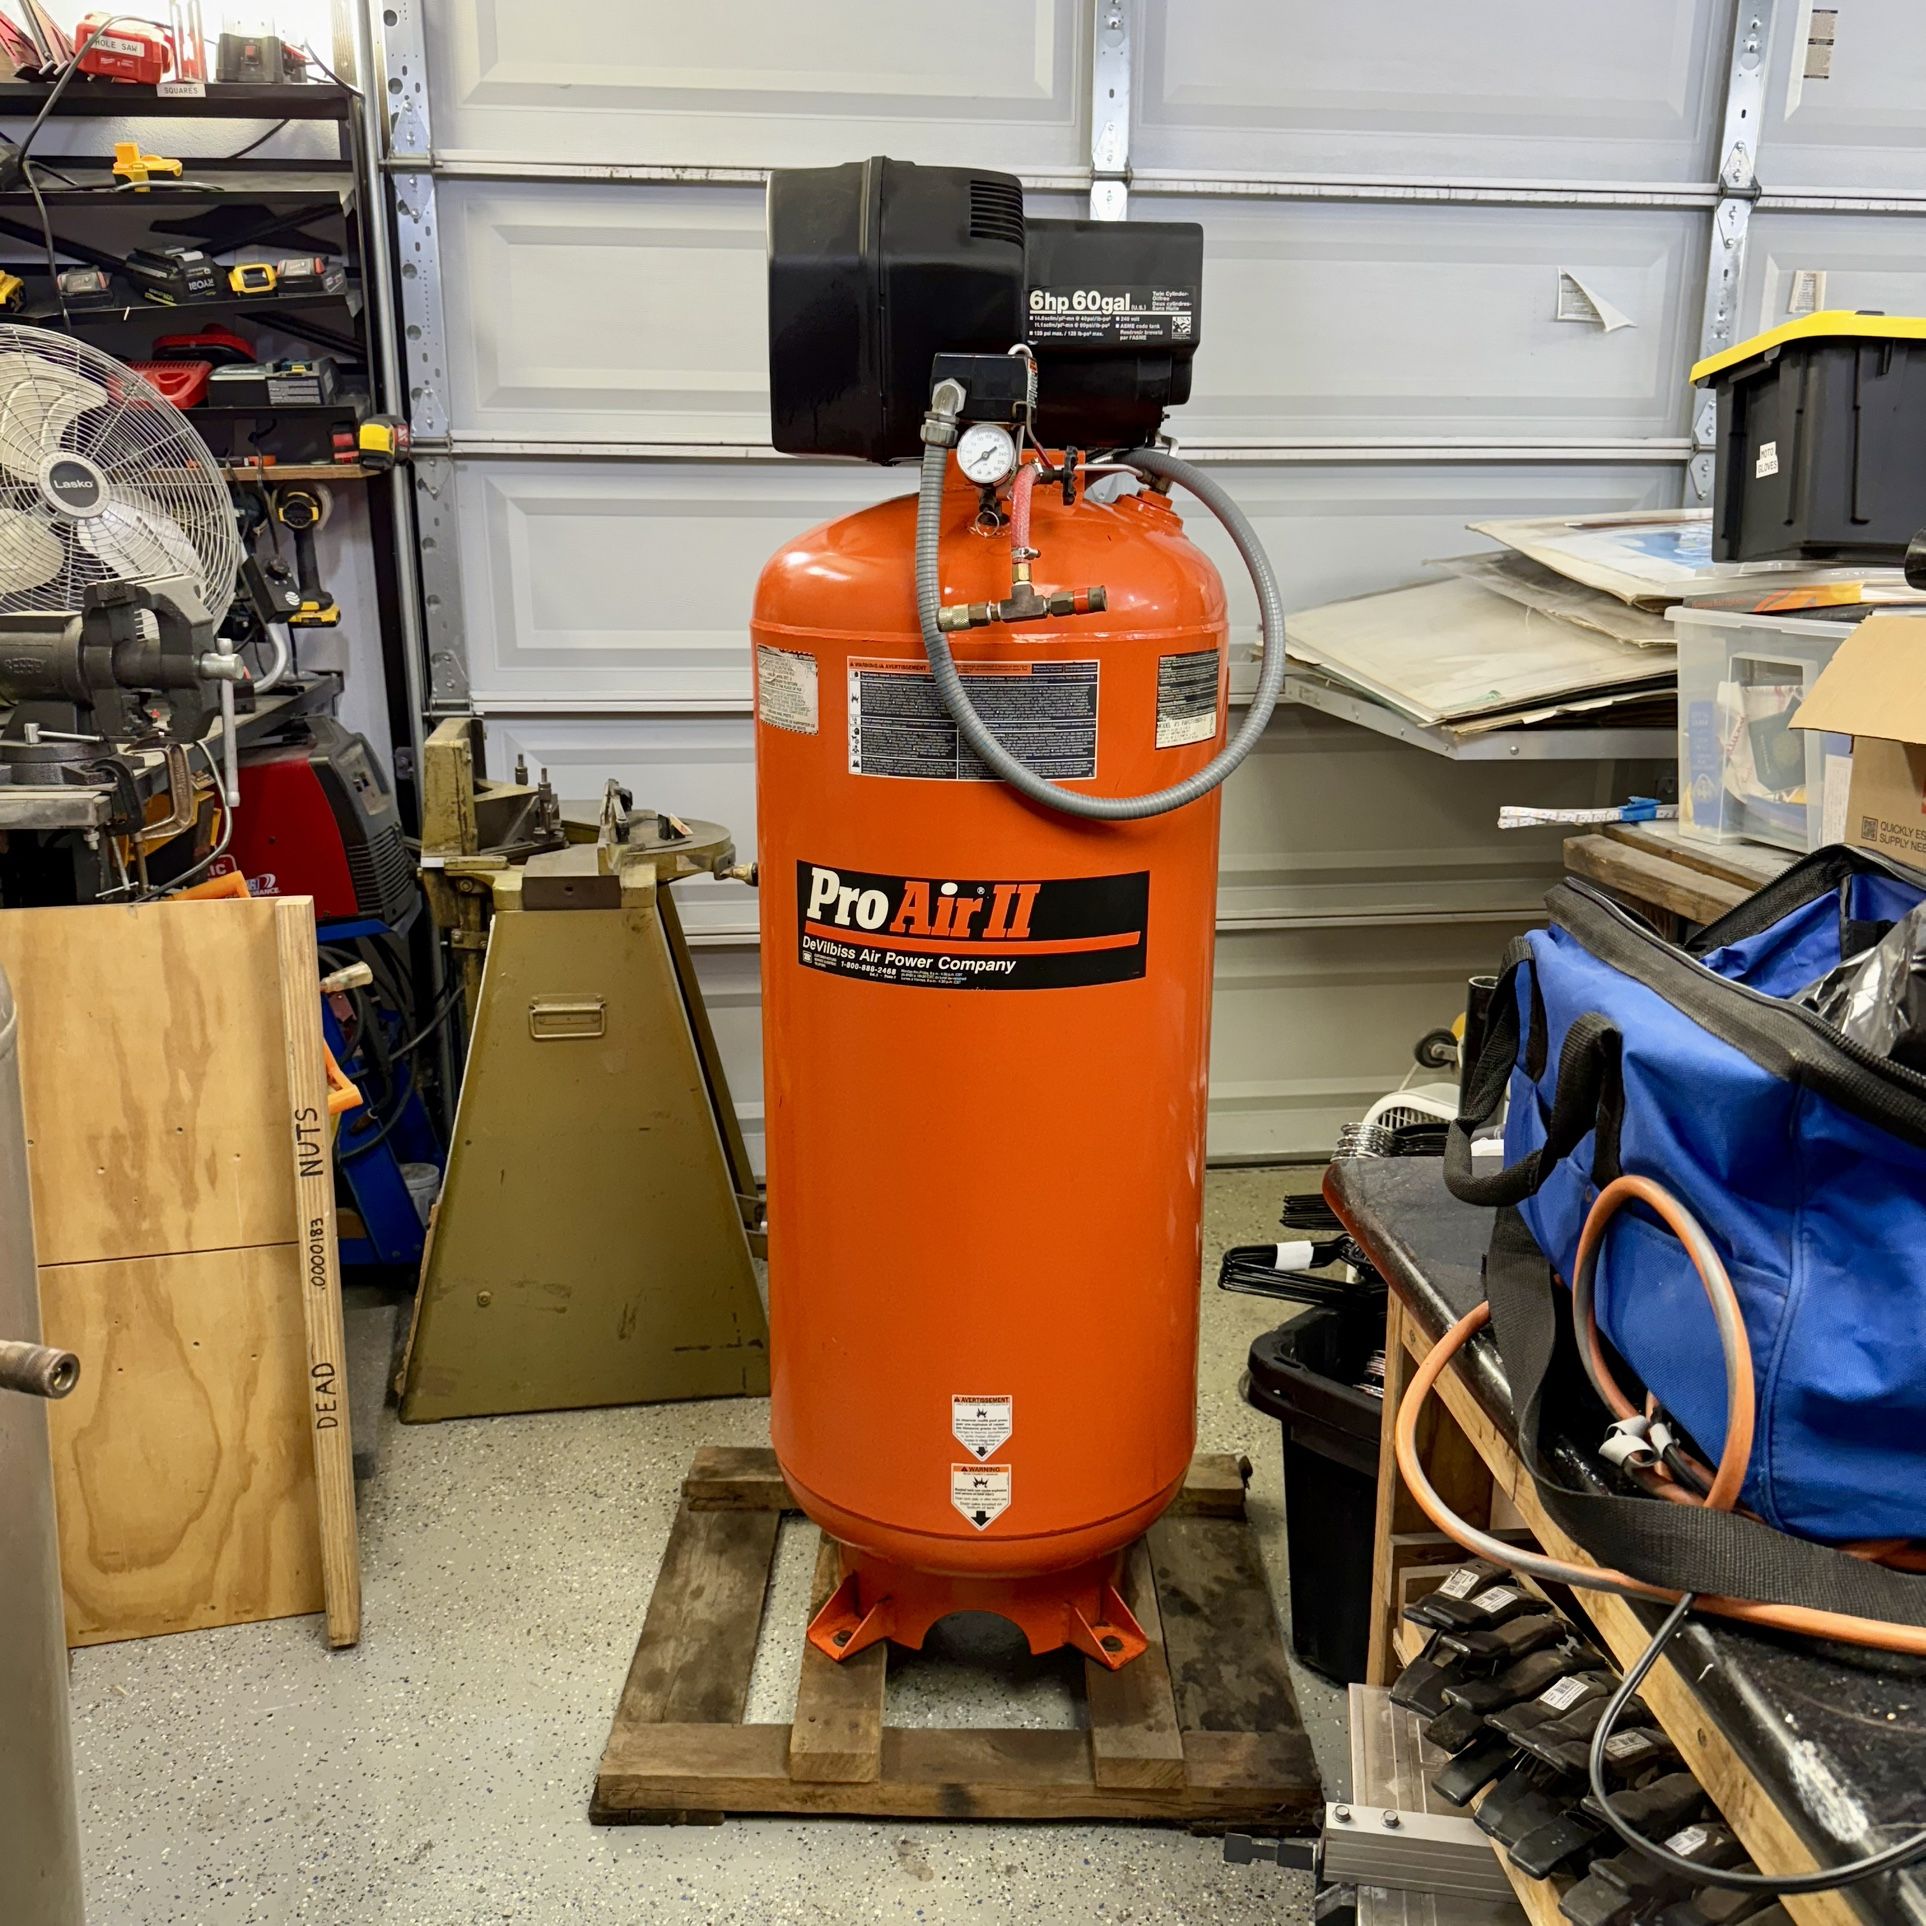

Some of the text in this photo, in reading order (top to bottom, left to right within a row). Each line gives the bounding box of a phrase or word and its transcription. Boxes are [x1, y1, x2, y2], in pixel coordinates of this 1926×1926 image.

[95, 39, 138, 52] HOLE SAW
[164, 86, 198, 94] SQUARES
[188, 278, 215, 291] RYOBI
[1029, 290, 1069, 314] 6hp
[1072, 290, 1130, 315] 60gal
[1761, 447, 1774, 458] MOTO
[1758, 460, 1777, 473] GLOVES
[54, 479, 93, 488] Lasko
[1881, 821, 1914, 838] QUICKLY
[1880, 833, 1909, 849] SUPPLY
[806, 867, 889, 930] Pro
[982, 884, 1041, 939] II
[803, 935, 1016, 974] DeVilbiss Air Power Company
[295, 1108, 338, 1429] DEAD .0000183 NUTS
